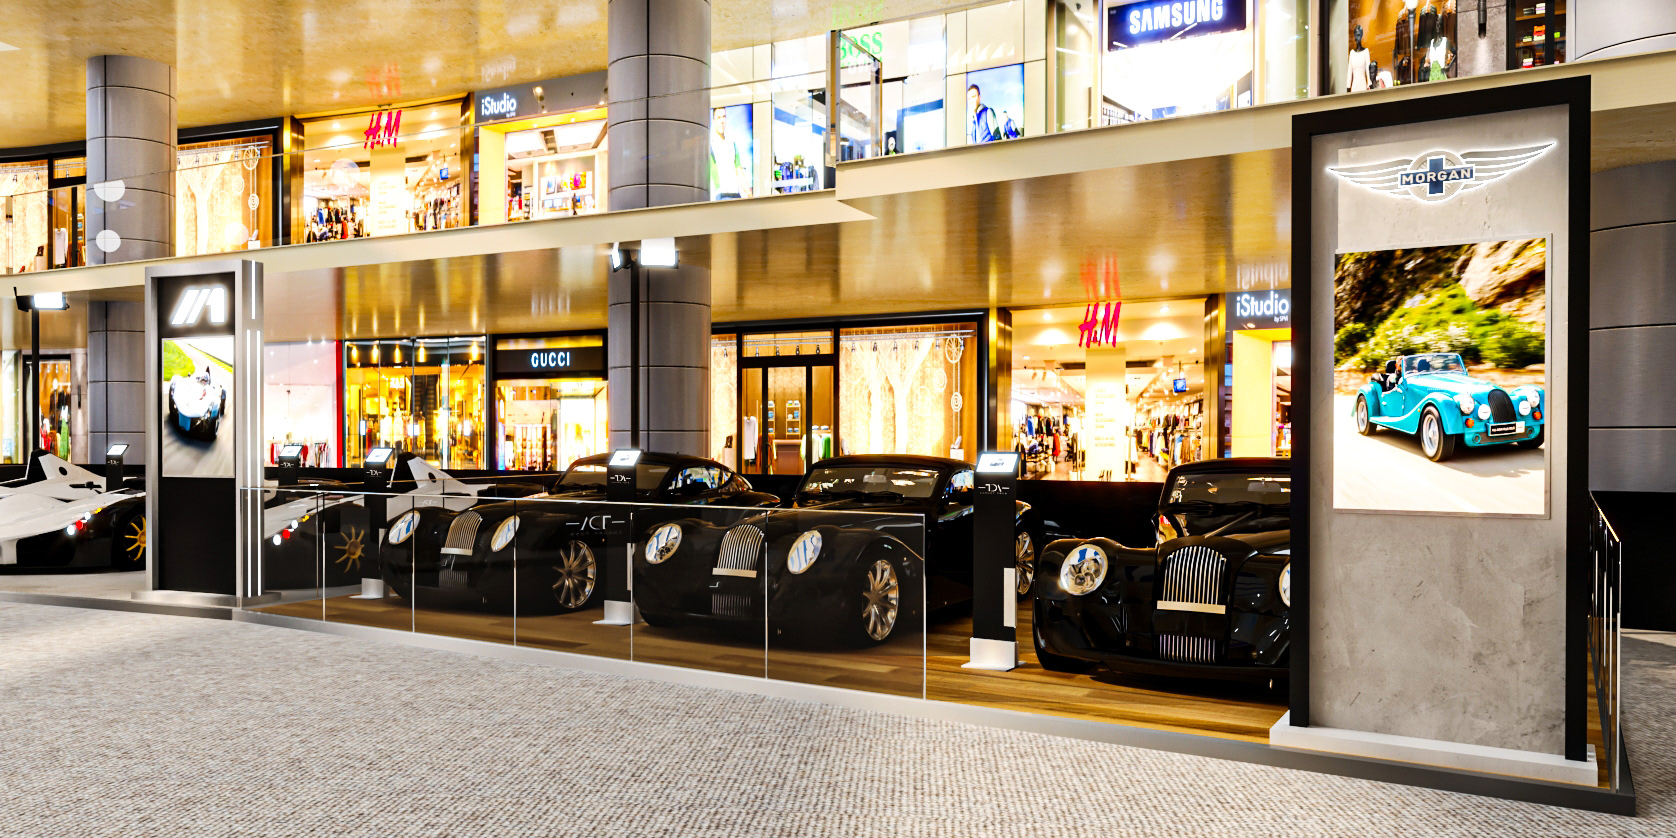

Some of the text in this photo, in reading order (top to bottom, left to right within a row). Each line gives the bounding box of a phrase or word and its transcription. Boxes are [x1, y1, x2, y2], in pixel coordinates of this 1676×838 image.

[1129, 0, 1223, 34] SAMSUNG
[481, 92, 517, 116] iStudio
[363, 109, 402, 150] H&M
[1401, 168, 1471, 185] MORGAN
[1236, 290, 1289, 317] iStudio
[1078, 301, 1122, 349] H&M
[531, 351, 570, 368] GUCCI
